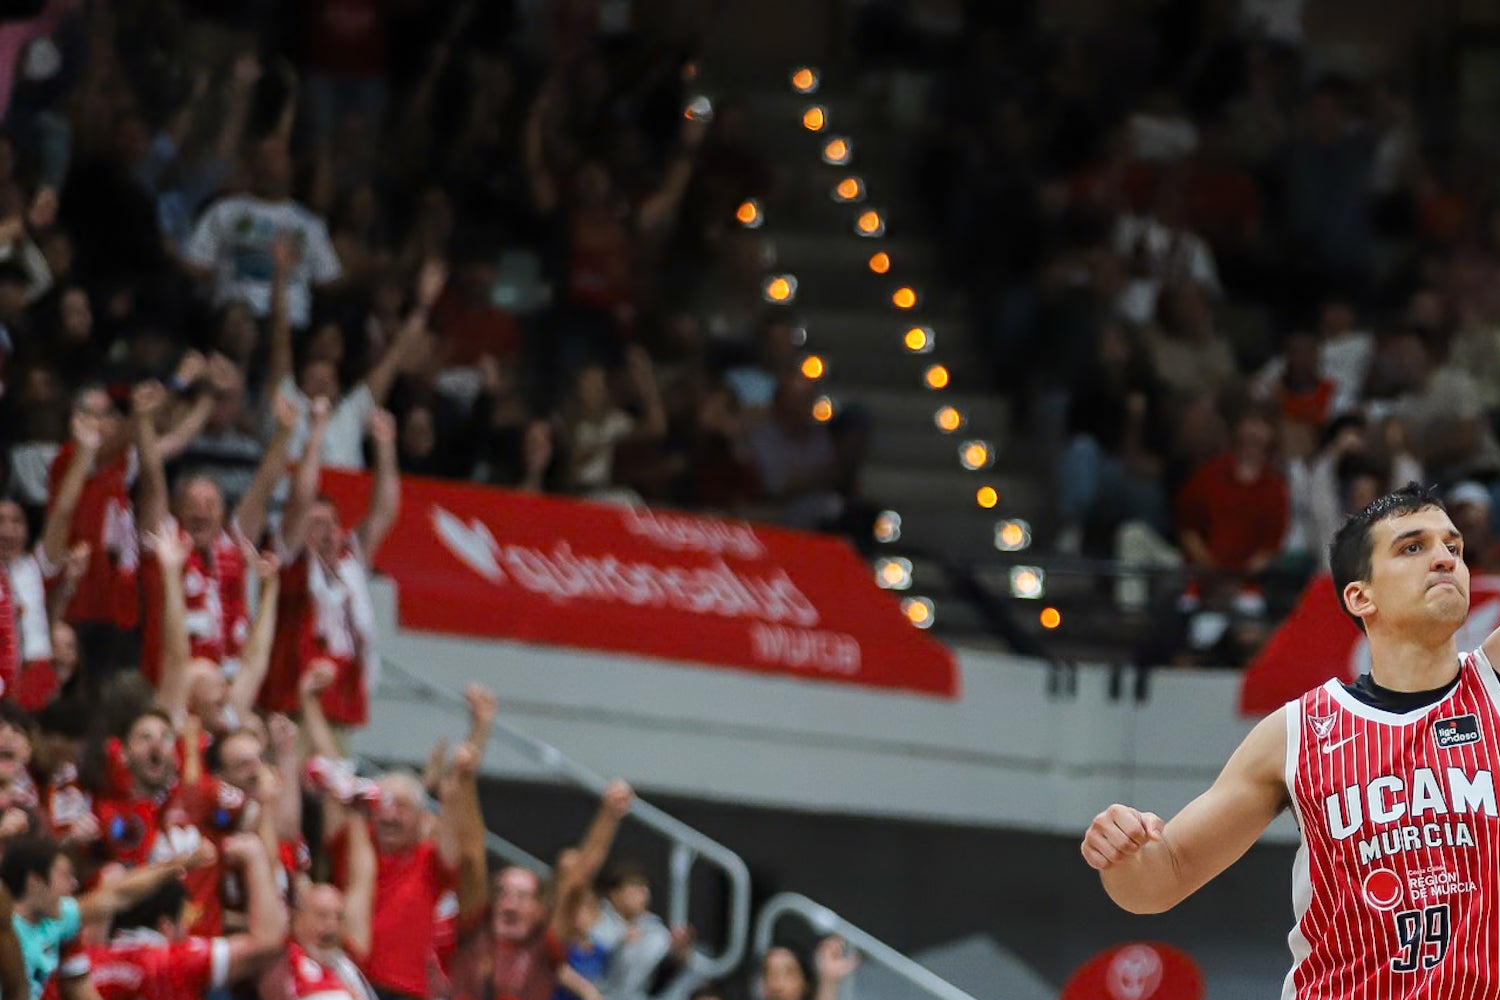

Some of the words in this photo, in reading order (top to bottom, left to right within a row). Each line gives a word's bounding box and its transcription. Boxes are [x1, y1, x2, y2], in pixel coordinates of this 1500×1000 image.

[1325, 766, 1499, 841] UCAM
[1358, 822, 1475, 866] MURCIA
[1409, 871, 1457, 889] REGIÓN
[1411, 888, 1428, 900] DE
[1431, 881, 1478, 896] MURCIA
[1390, 905, 1450, 974] 99
